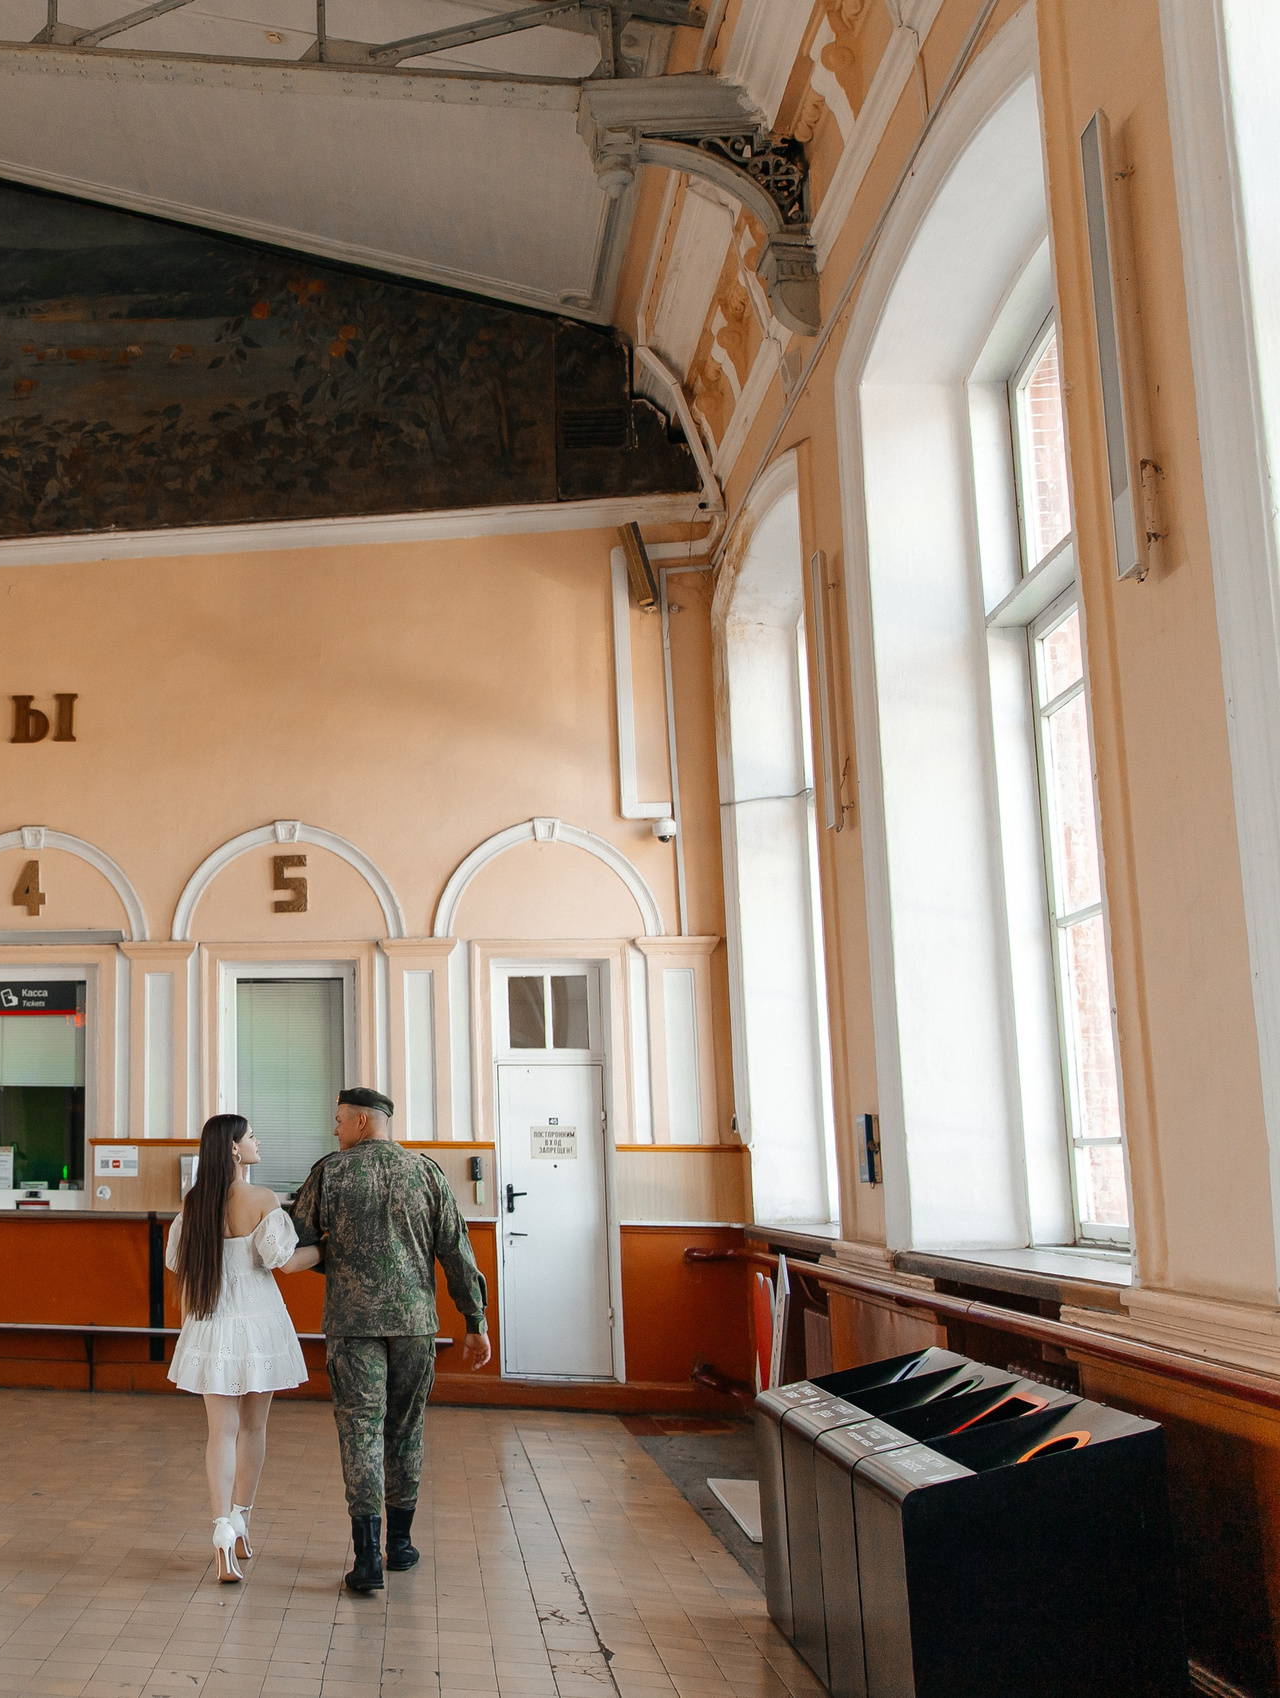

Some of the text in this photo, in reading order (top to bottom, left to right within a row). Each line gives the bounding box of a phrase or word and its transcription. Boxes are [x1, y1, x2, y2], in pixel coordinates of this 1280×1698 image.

[12, 860, 46, 917] 4
[273, 855, 308, 913] 5
[21, 988, 49, 997] Касса
[544, 1139, 562, 1147] ВХОД
[539, 1146, 573, 1154] ЗАПРЕЩЕН!
